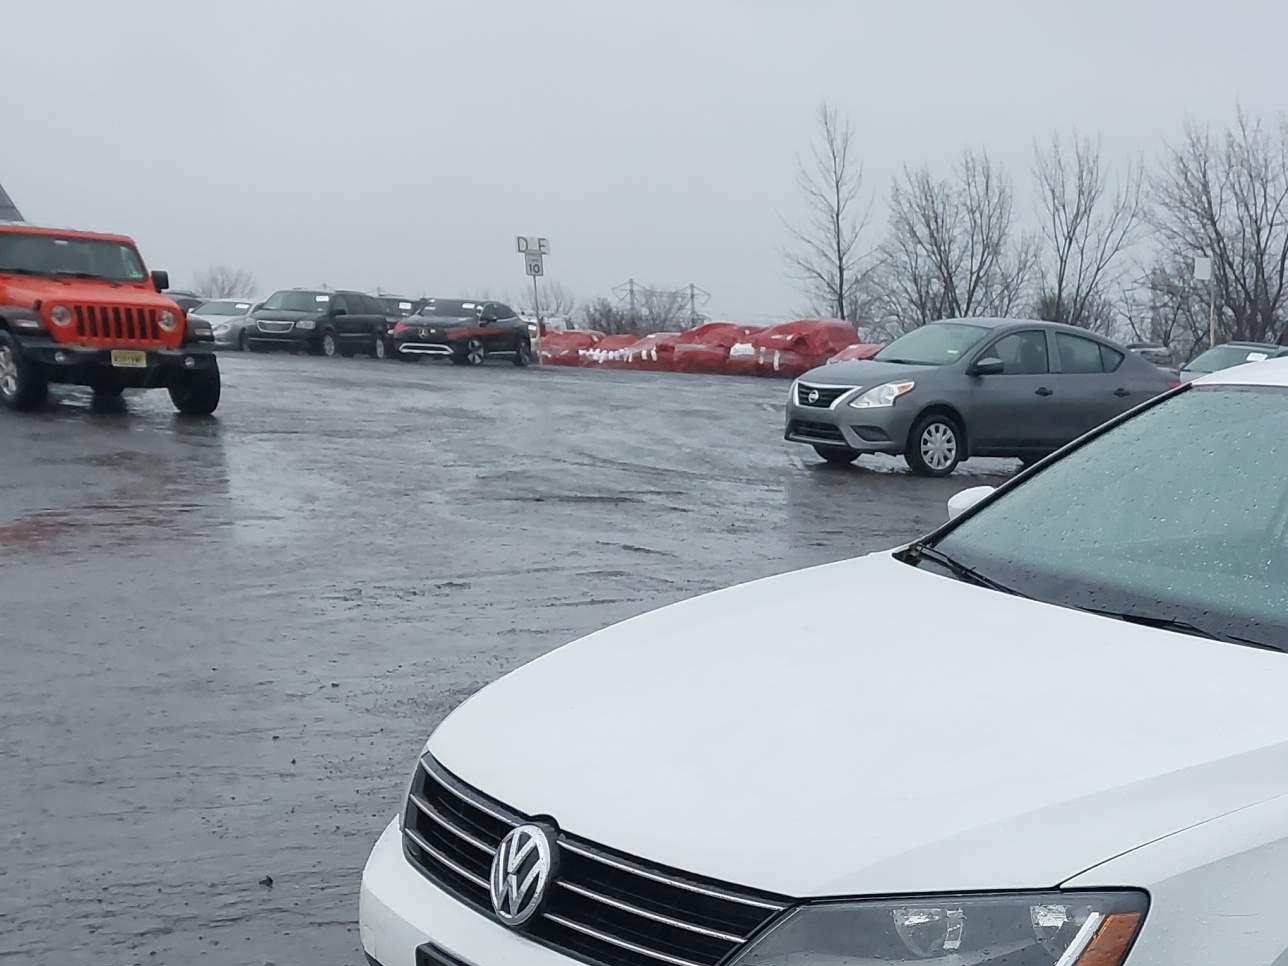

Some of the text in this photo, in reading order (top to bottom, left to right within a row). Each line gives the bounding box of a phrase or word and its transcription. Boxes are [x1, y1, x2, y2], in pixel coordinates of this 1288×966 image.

[516, 236, 529, 253] D
[529, 263, 540, 274] 10
[491, 825, 550, 925] VW
